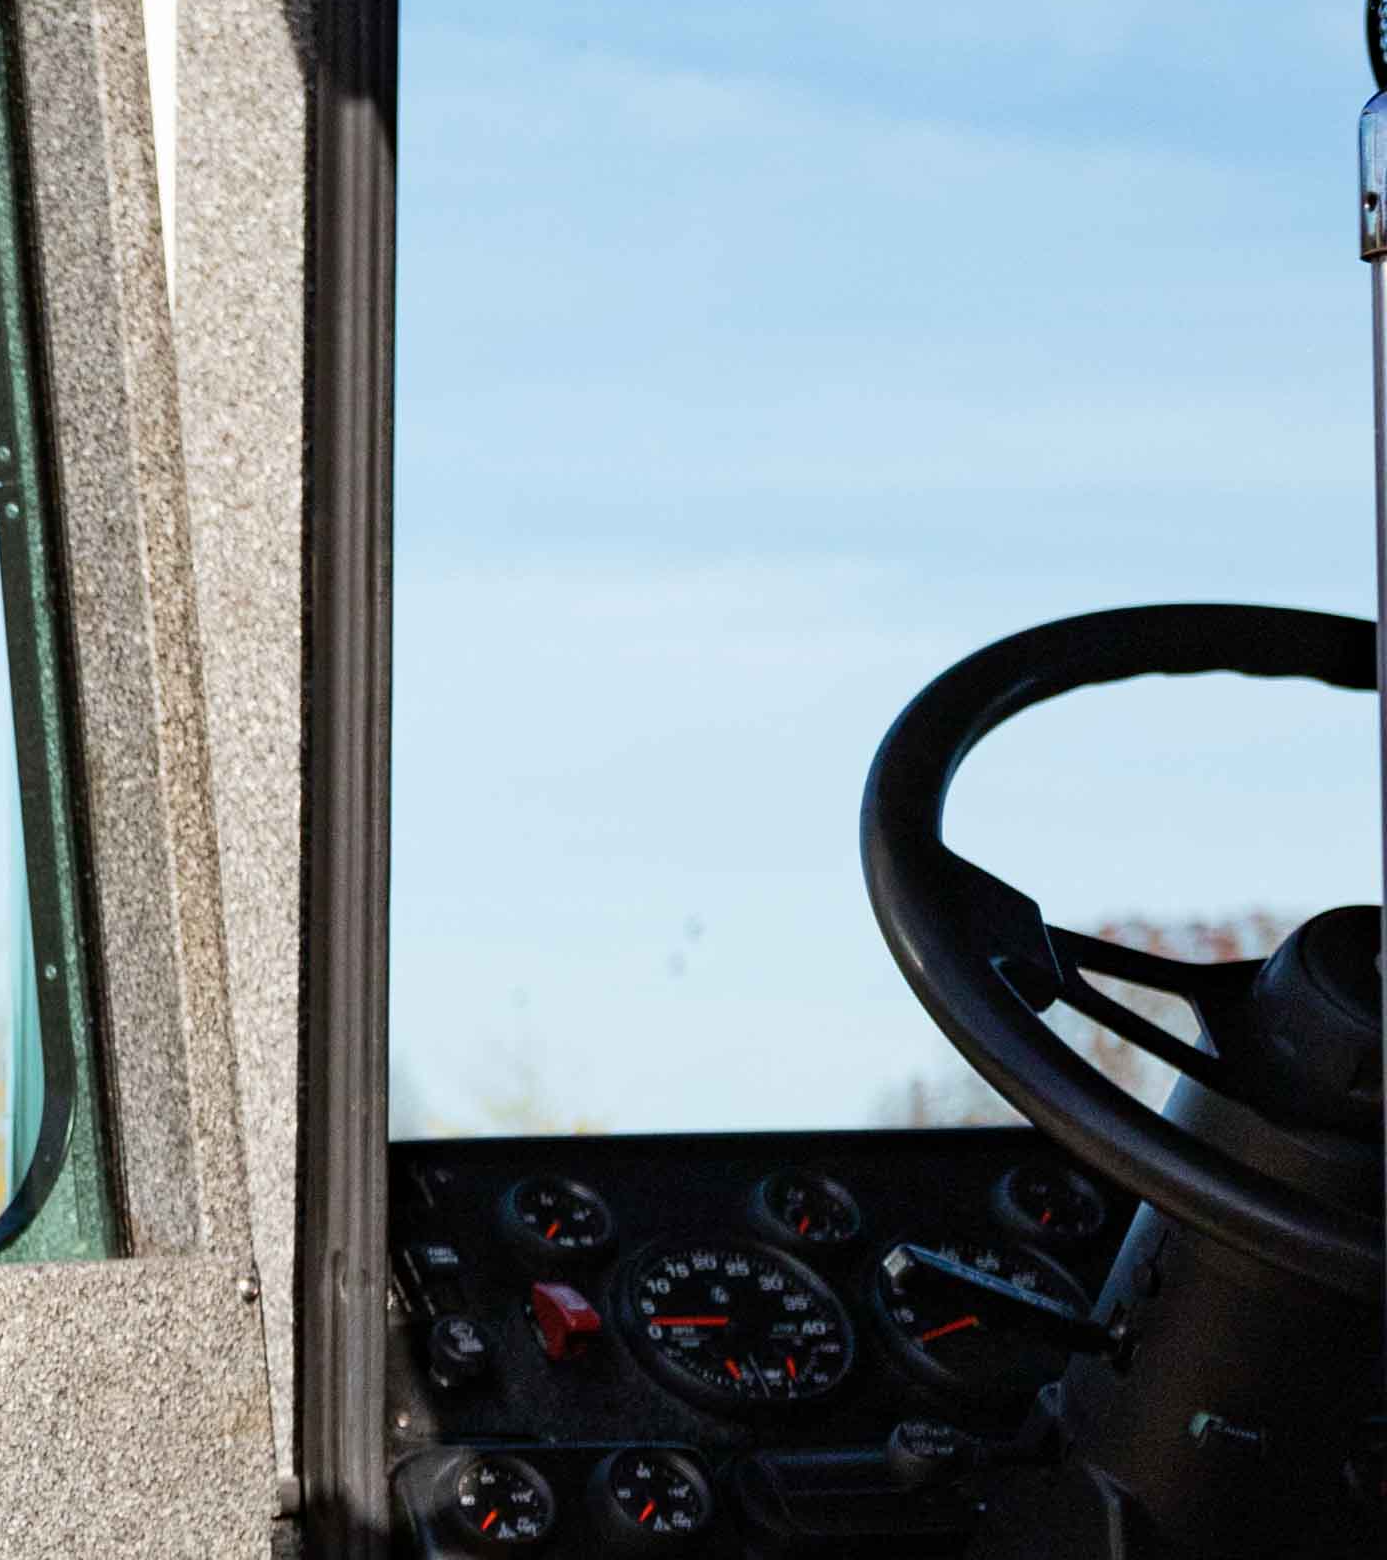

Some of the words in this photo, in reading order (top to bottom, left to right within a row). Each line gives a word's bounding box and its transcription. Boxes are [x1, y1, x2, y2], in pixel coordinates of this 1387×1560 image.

[692, 1254, 717, 1271] 20
[725, 1260, 750, 1277] 25
[666, 1263, 689, 1279] 15
[647, 1277, 671, 1295] 10
[759, 1275, 784, 1291] 30
[641, 1299, 656, 1315] 5
[647, 1324, 663, 1340] 0
[801, 1321, 827, 1336] 40
